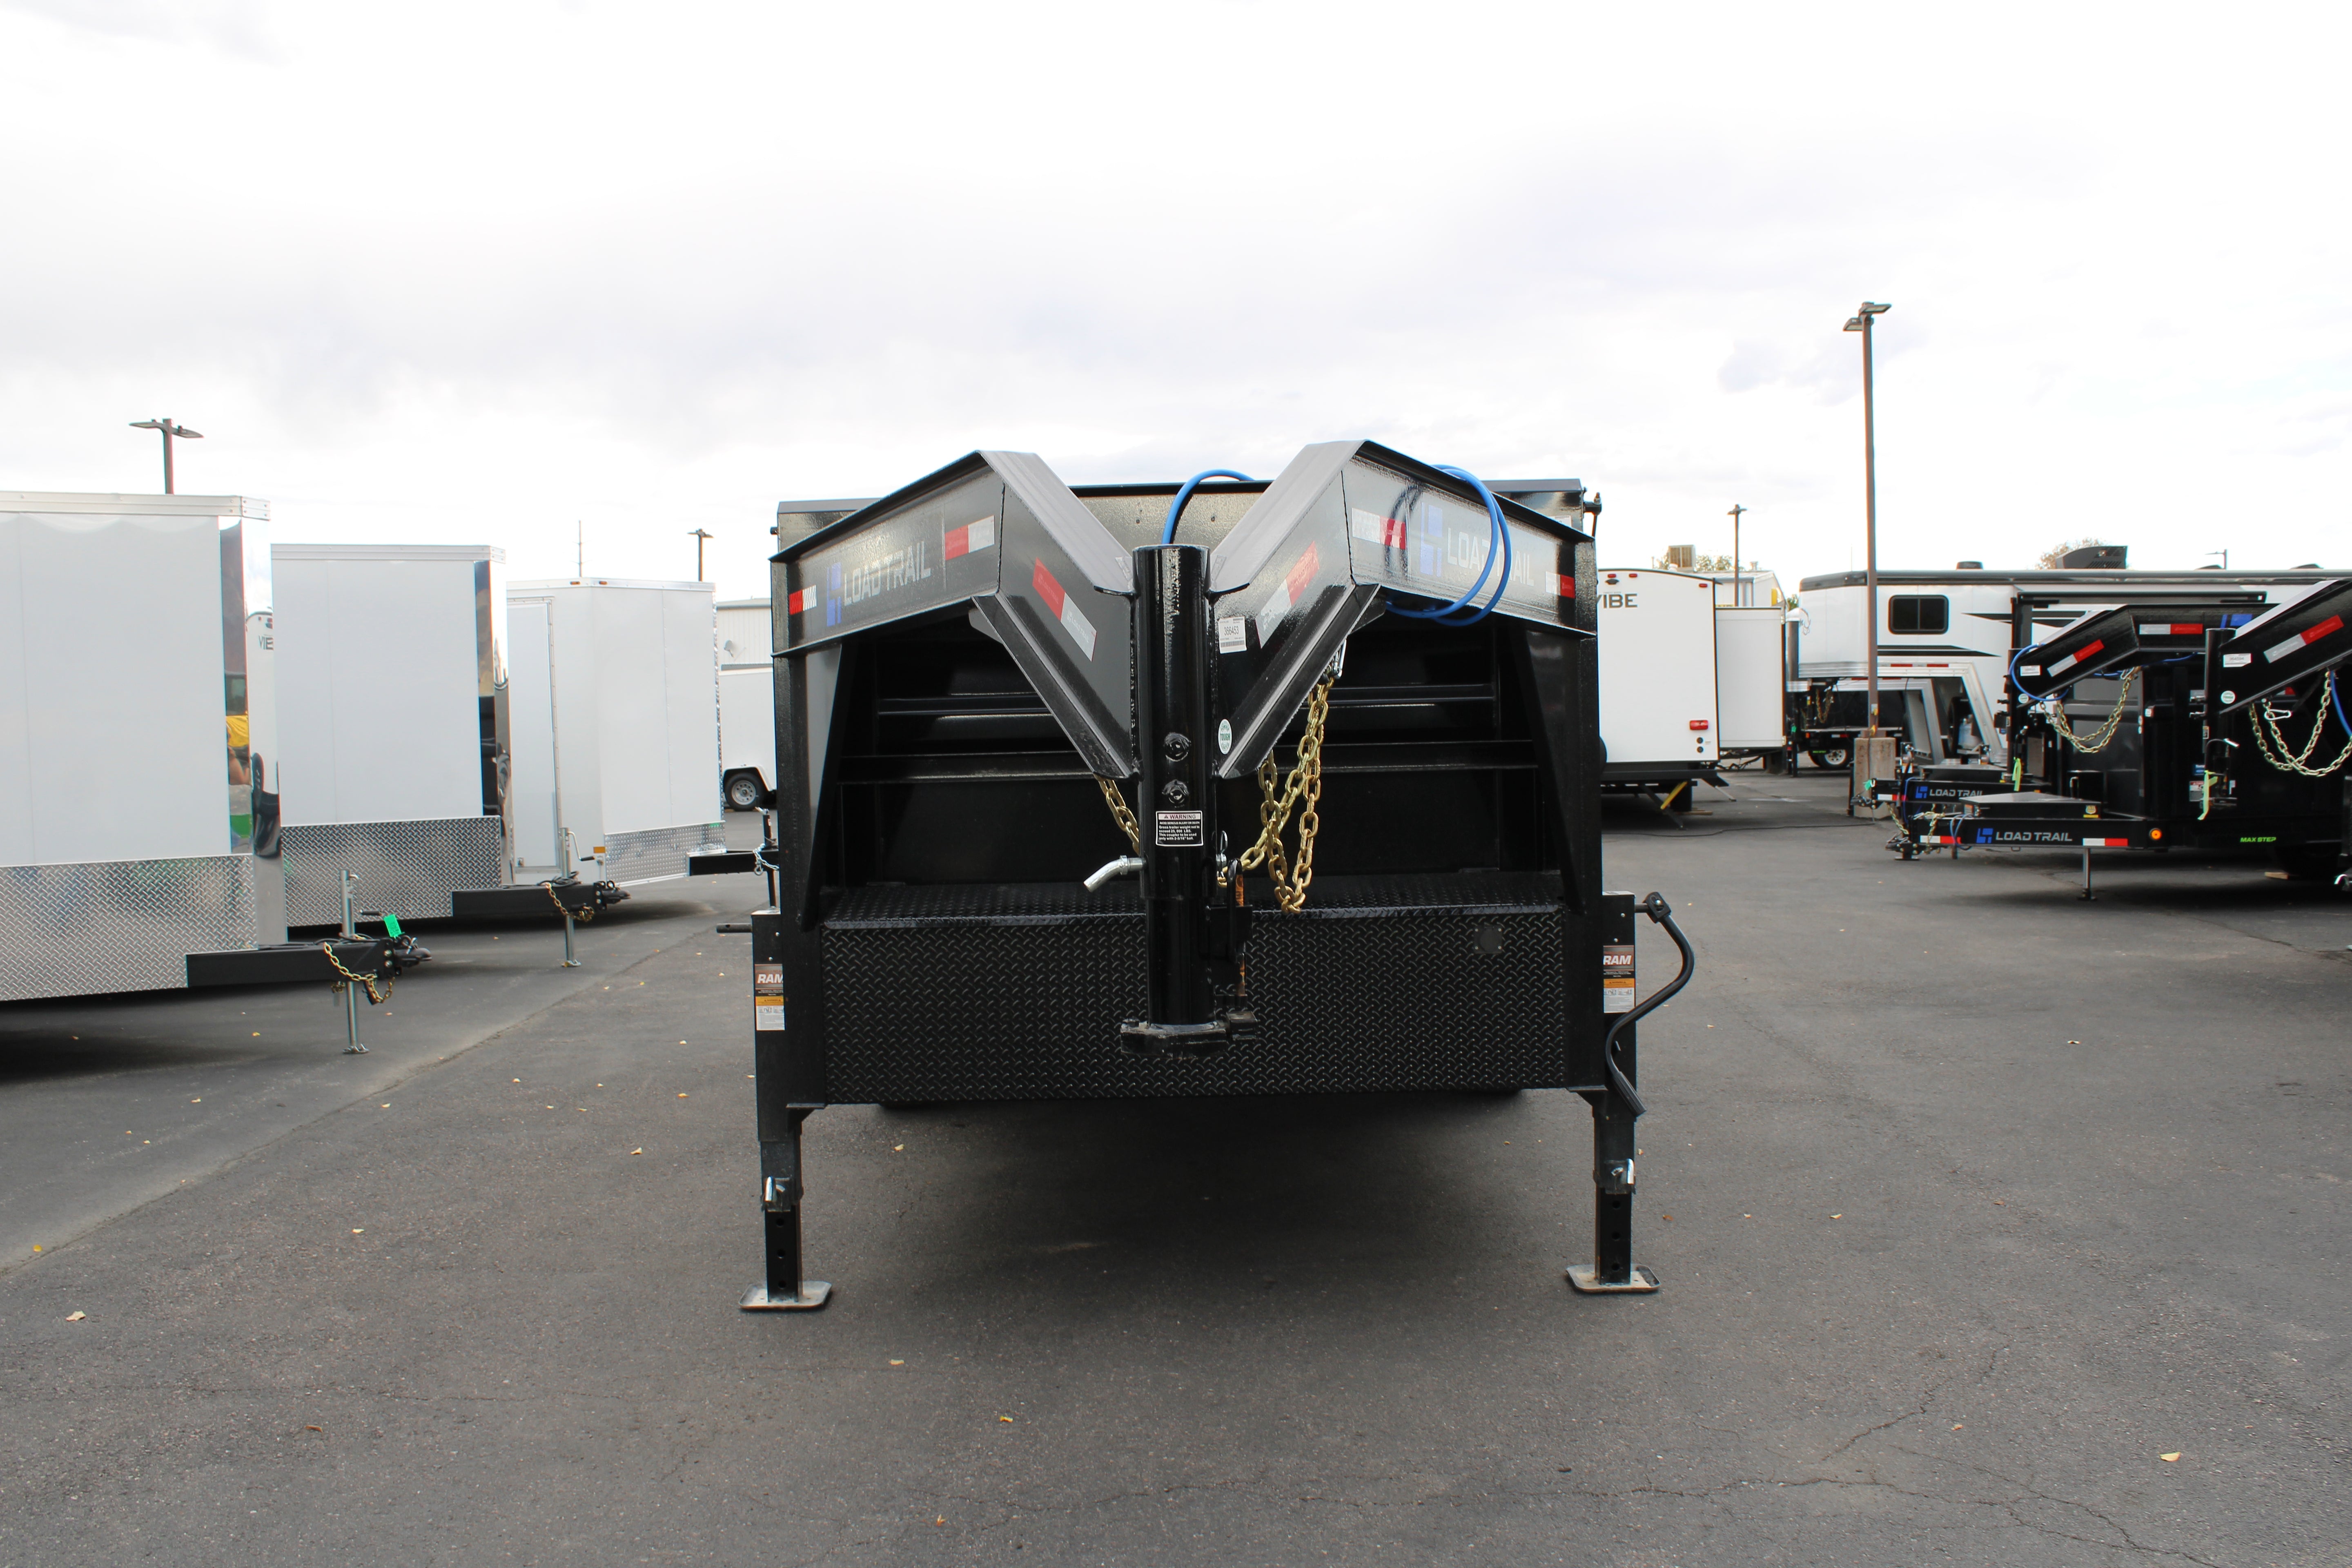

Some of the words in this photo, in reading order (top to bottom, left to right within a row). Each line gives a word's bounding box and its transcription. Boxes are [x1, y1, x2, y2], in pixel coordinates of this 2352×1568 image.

[1496, 544, 1534, 587] TAIL
[844, 559, 881, 606] LOAD
[883, 541, 931, 591] TRAIL
[1224, 626, 1239, 636] 366453
[1996, 831, 2032, 841] LOAD
[2034, 832, 2073, 841] TRAIL
[1603, 955, 1632, 965] RAM
[757, 973, 784, 984] RAM
